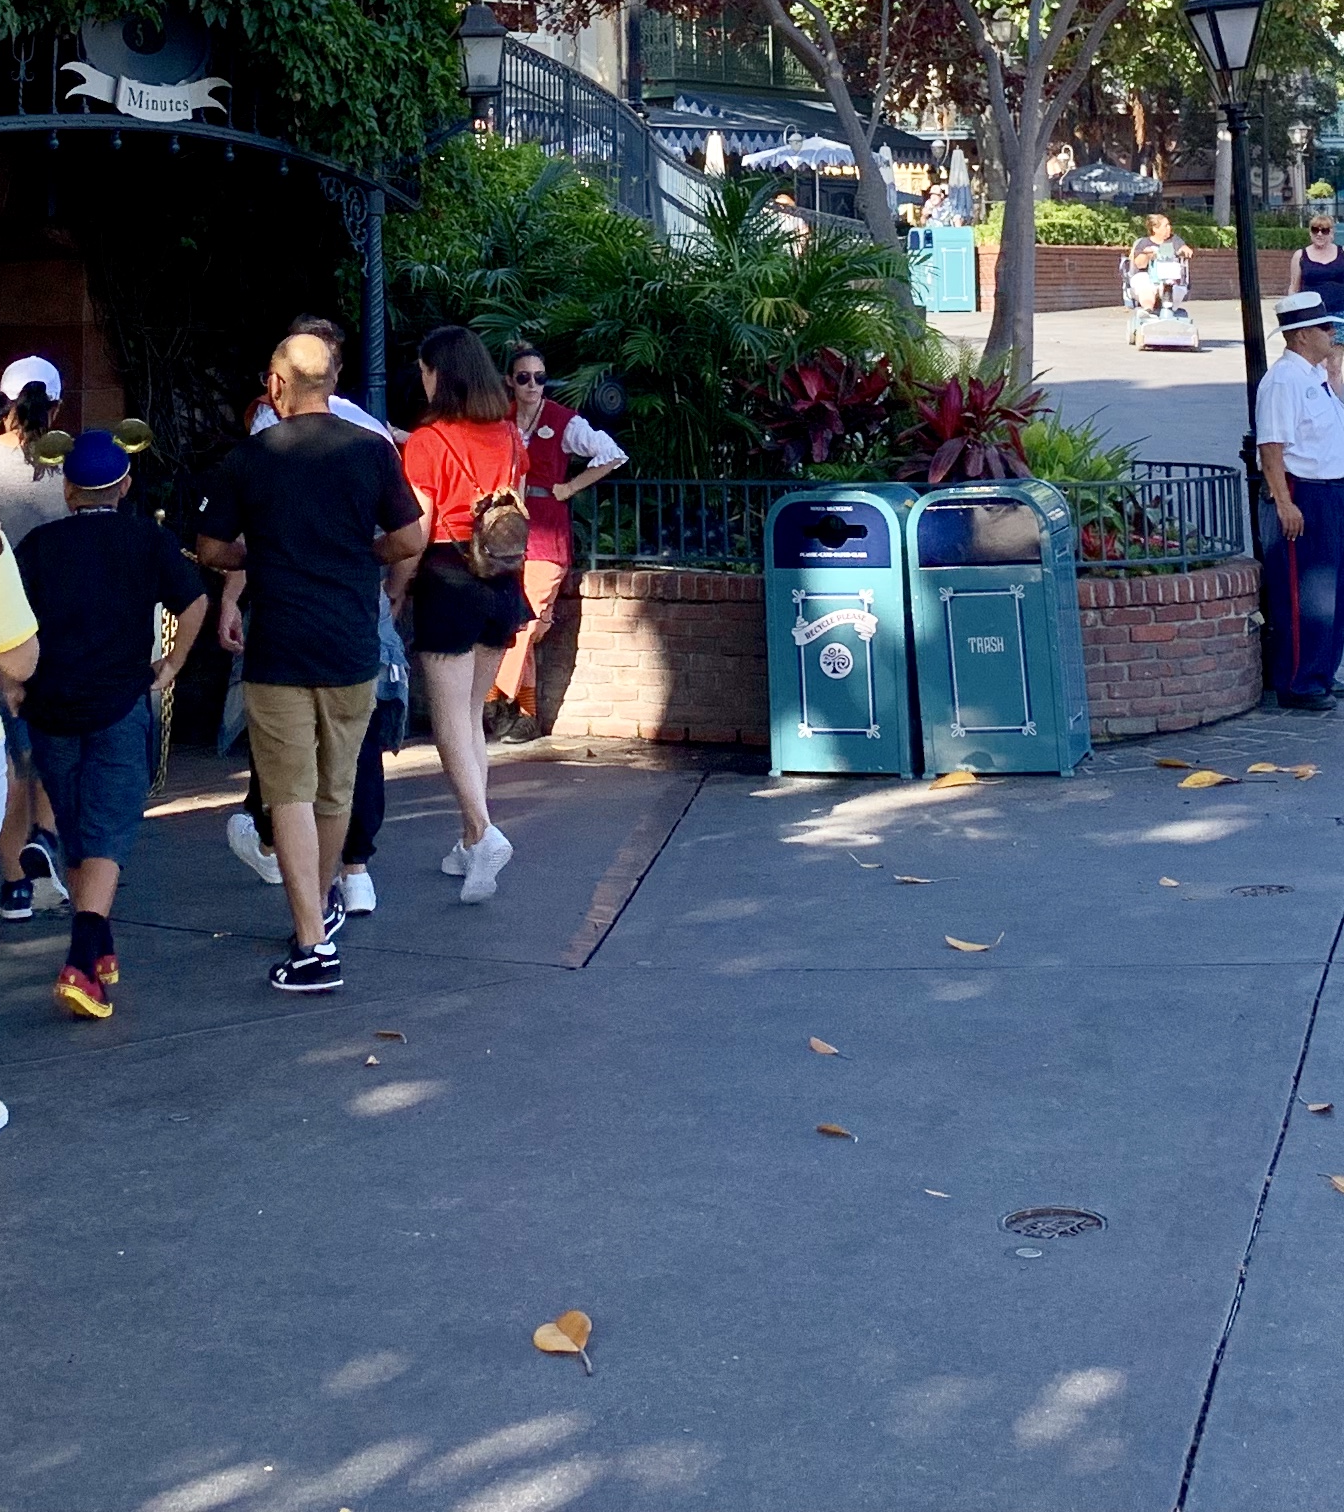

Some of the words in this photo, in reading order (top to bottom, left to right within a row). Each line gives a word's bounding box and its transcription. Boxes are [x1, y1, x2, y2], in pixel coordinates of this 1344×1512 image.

[127, 86, 190, 113] Minutes
[804, 617, 836, 640] RECYCLE
[836, 613, 867, 622] PLEASE
[967, 636, 1005, 654] TRASH
